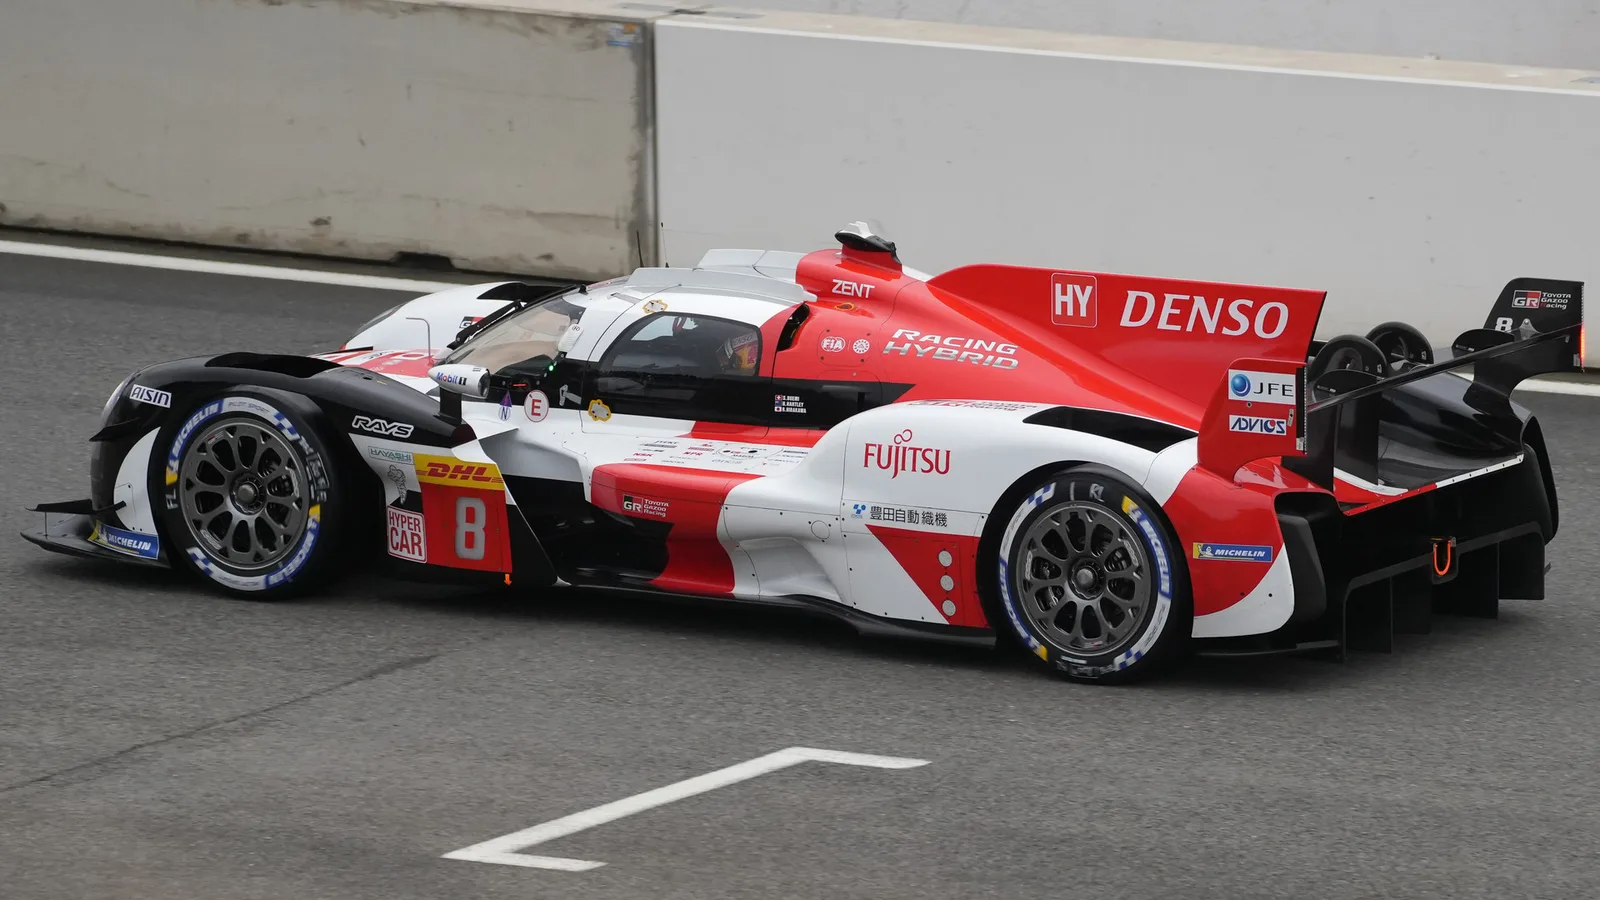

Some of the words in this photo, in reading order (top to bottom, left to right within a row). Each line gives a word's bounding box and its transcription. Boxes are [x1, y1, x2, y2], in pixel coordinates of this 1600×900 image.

[831, 279, 875, 299] ZENT
[1054, 283, 1092, 317] HY
[1514, 297, 1539, 307] GR
[1540, 302, 1567, 311] Racing
[1119, 290, 1289, 339] DENSO
[1495, 317, 1513, 333] 8
[892, 329, 1018, 355] RACING
[883, 341, 1019, 370] HYBRID
[436, 372, 458, 385] Mobil
[133, 386, 169, 407] AISIN
[1253, 382, 1294, 397] JFE
[500, 406, 509, 420] N
[172, 402, 218, 457] MICHELIN
[352, 415, 415, 439] RAYS
[1231, 417, 1285, 434] ADVICS
[371, 448, 412, 461] HAYASHI
[863, 442, 951, 480] FUJITSU
[426, 462, 491, 484] DHL
[623, 501, 642, 513] GR
[643, 504, 667, 512] GAZOO
[644, 499, 669, 507] TOYOTA
[389, 510, 421, 533] HYPER
[643, 509, 667, 518] Racing
[455, 496, 486, 560] 8
[108, 533, 152, 551] MICHELIN
[390, 530, 423, 557] CAR
[1141, 520, 1169, 595] MICHELIN
[1214, 548, 1266, 557] MICHELIN
